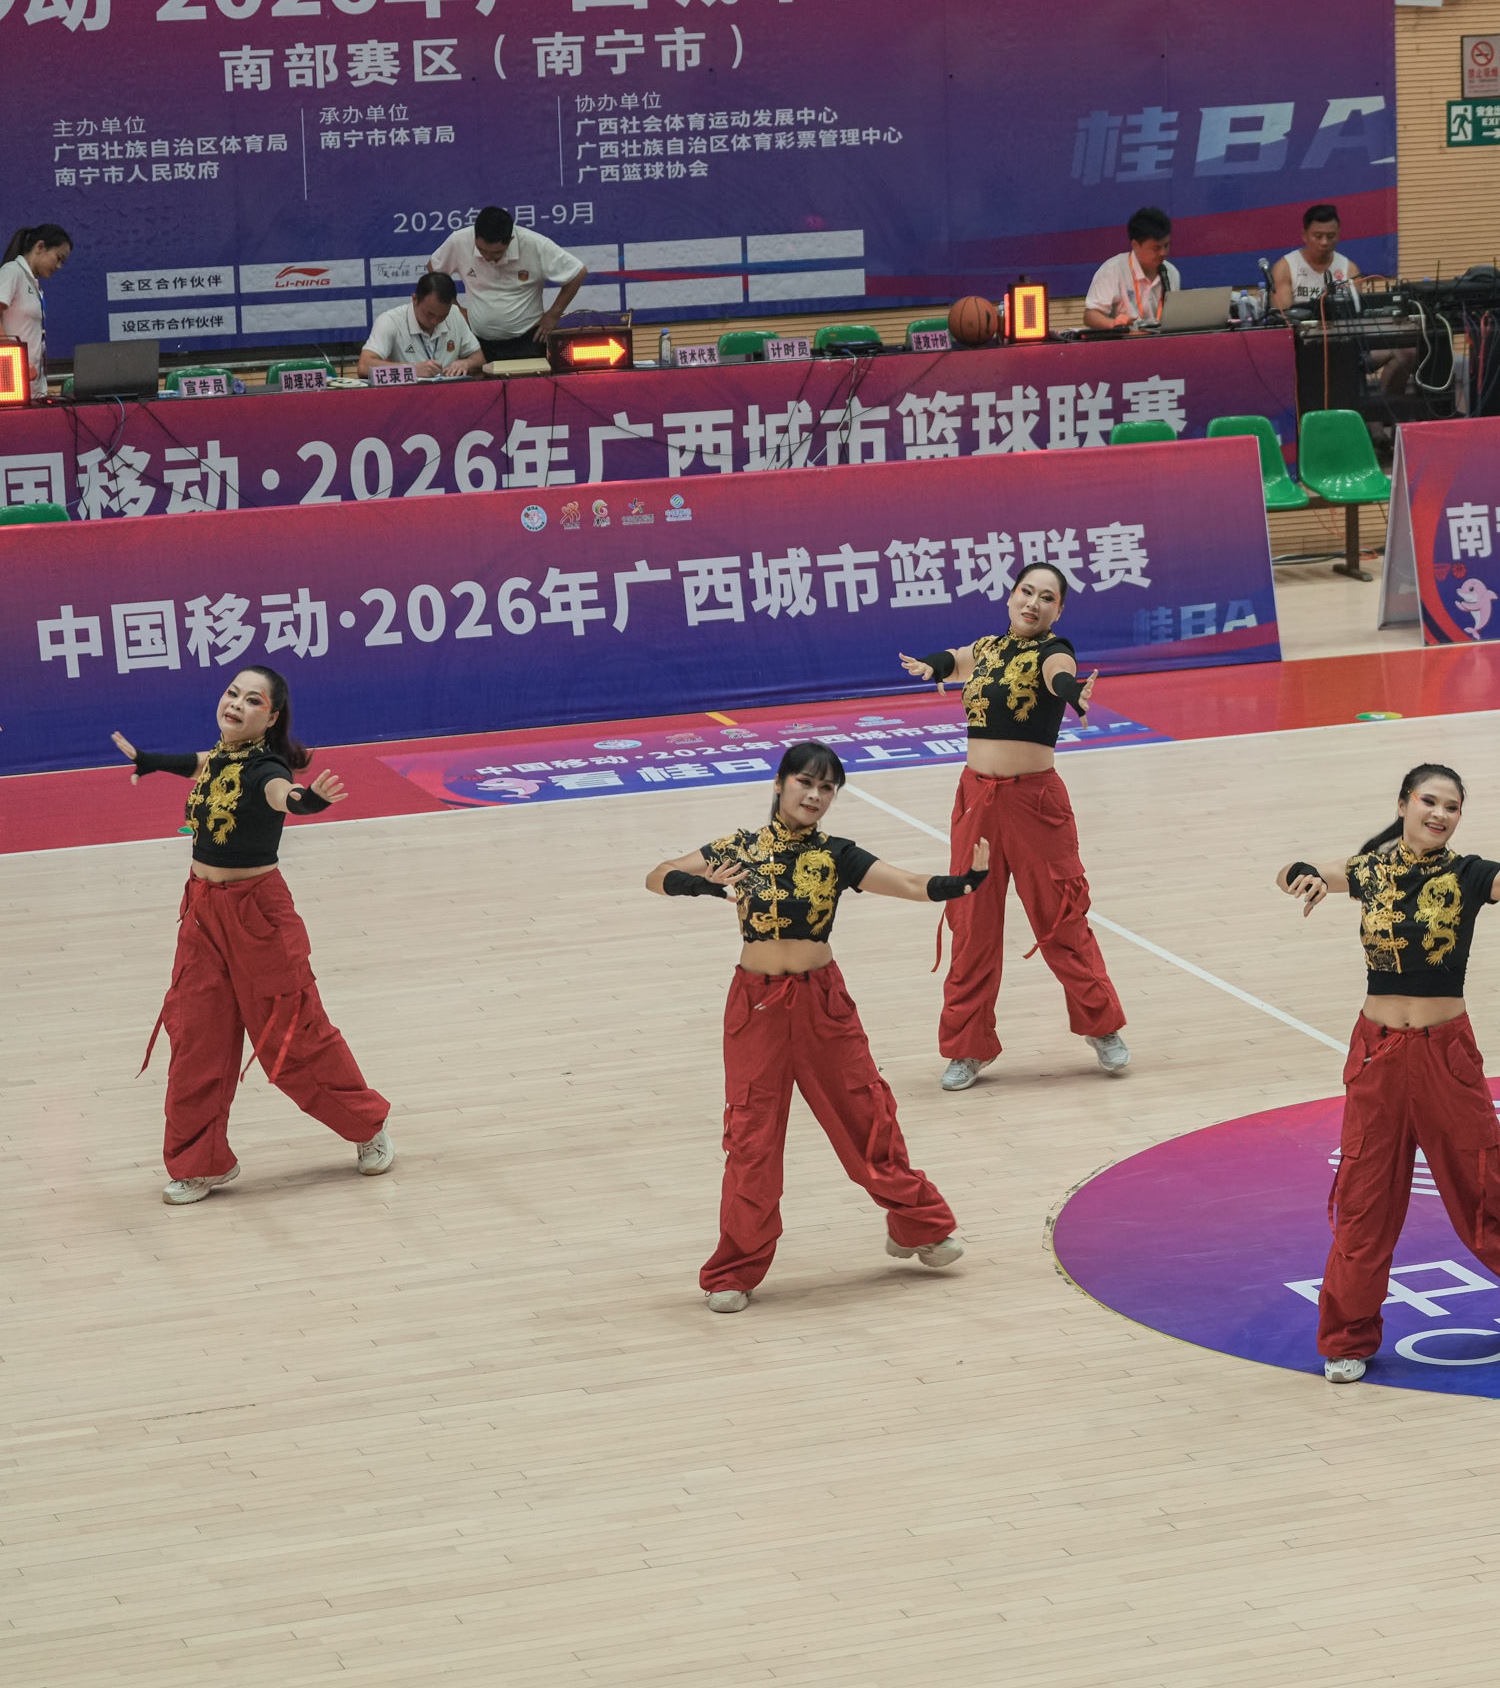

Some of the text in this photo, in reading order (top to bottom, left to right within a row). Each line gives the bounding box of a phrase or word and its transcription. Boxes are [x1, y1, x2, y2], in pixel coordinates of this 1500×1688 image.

[575, 91, 662, 112] 协办单位
[319, 104, 409, 125] 承办单位
[576, 106, 839, 136] 广西社会体育运动发展中心
[52, 115, 146, 137] 主办单位
[53, 133, 288, 162] 广西壮族自治区体育局
[319, 125, 456, 150] 南宁市体育局
[577, 127, 903, 160] 广西壮族自治区体育彩票管理中心
[1071, 95, 1395, 186] 桂BA
[55, 161, 220, 187] 南宁市人民政府
[578, 160, 709, 184] 广西篮球协会
[393, 201, 594, 233] 2026年月-9月
[120, 274, 222, 292] 全区合作伙伴
[275, 278, 331, 288] LI-NING
[1015, 286, 1045, 338] 0
[122, 315, 224, 333] 设区市合作伙伴
[770, 341, 810, 358] 计时员
[913, 332, 949, 349] 进攻计时
[679, 346, 718, 364] 技术代表
[283, 371, 325, 390] 助理记录
[375, 367, 415, 384] 记录员
[184, 378, 225, 395] 宣告员
[1132, 600, 1258, 645] 桂BA
